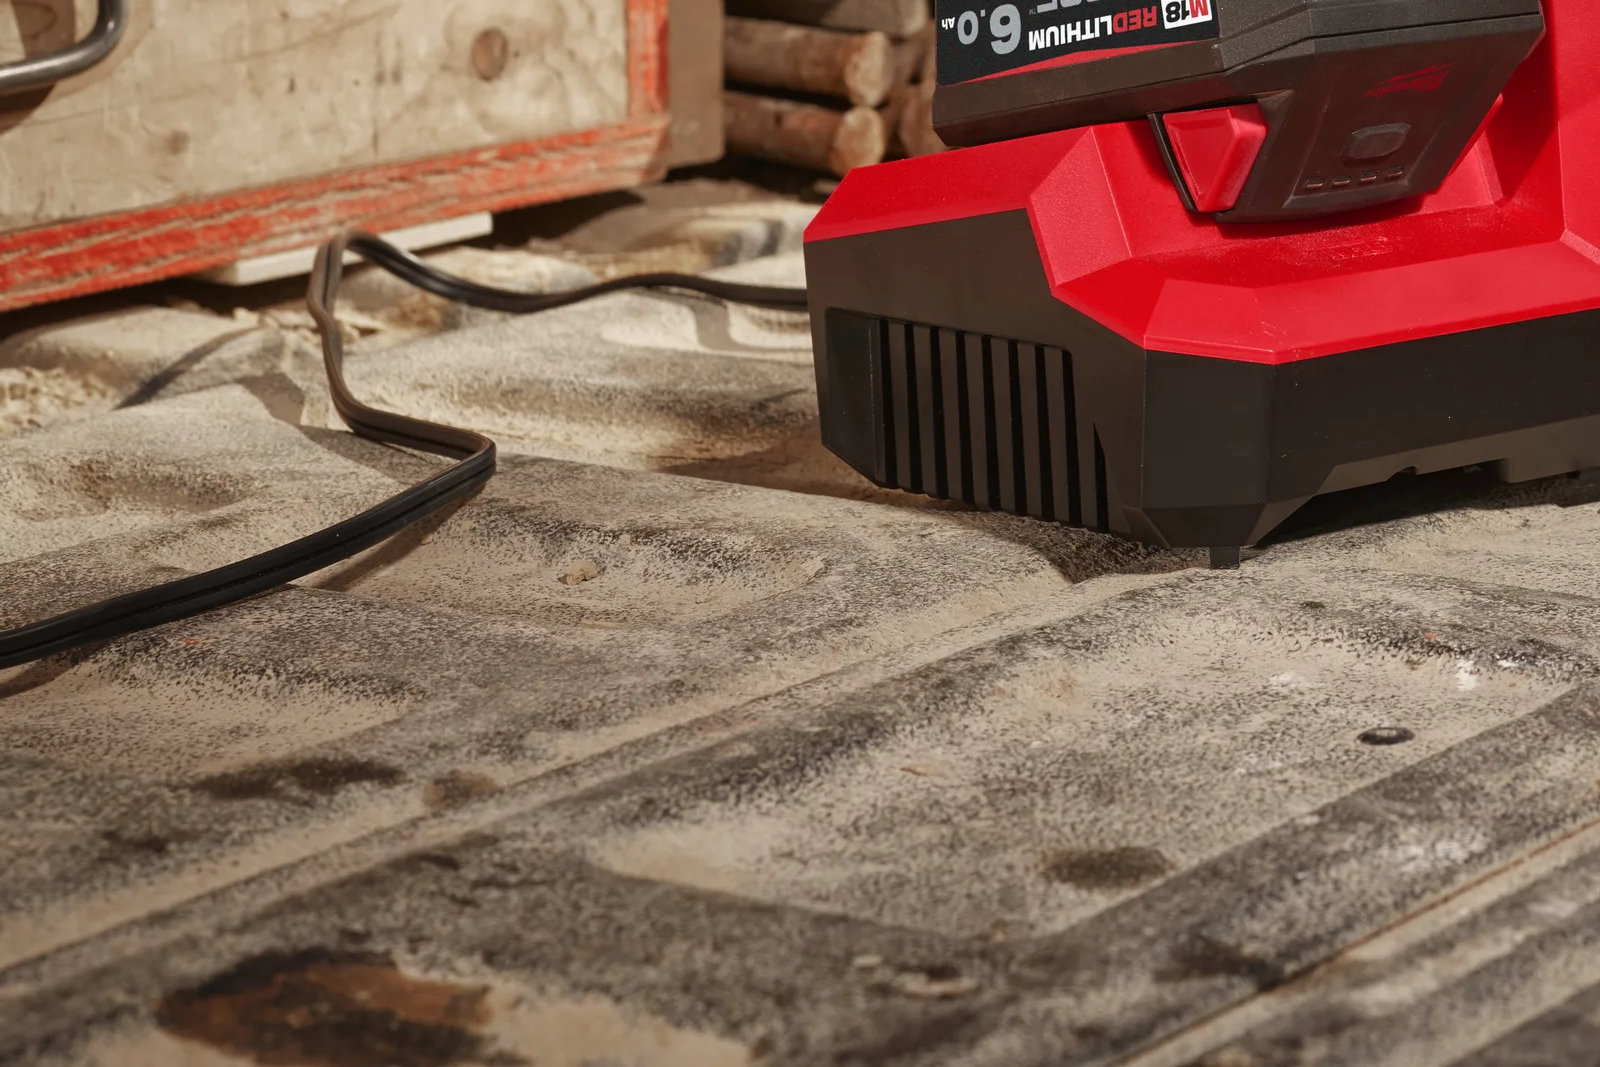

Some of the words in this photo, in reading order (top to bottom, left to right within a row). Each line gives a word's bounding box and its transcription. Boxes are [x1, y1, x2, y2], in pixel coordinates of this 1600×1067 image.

[941, 17, 956, 29] Ah
[957, 3, 1022, 55] 6.0
[1028, 5, 1158, 51] REDLITHIUM
